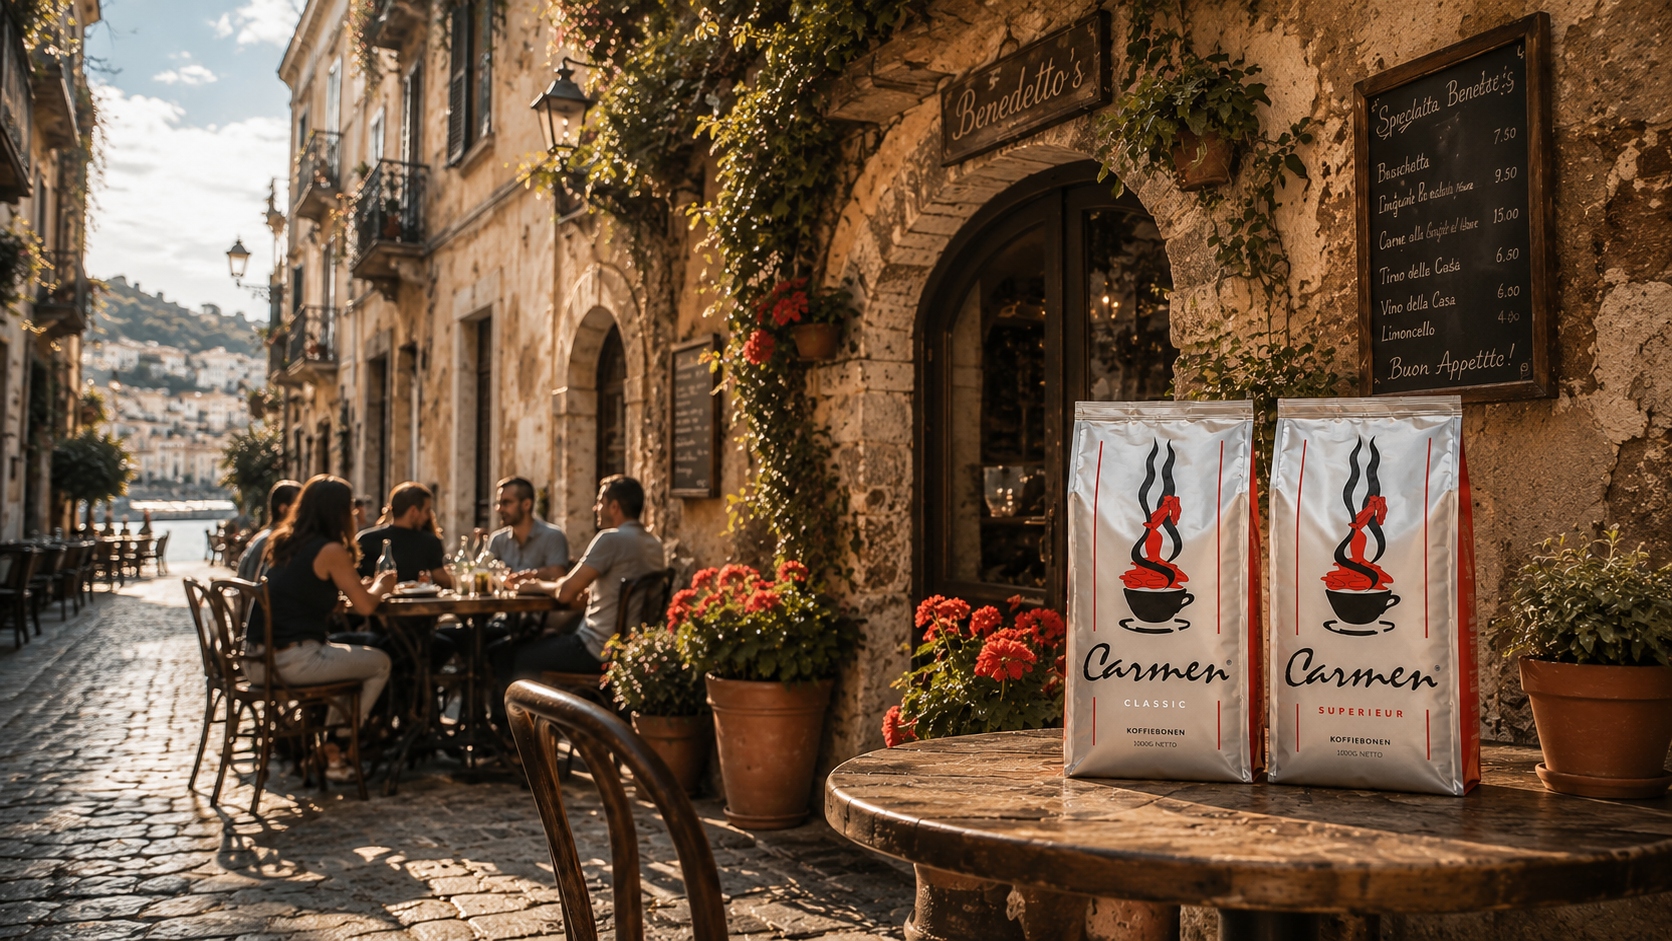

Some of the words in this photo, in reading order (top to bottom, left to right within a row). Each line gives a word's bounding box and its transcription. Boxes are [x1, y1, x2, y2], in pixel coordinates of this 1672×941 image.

[952, 47, 1086, 141] Benedetto's
[1493, 127, 1517, 145] 7.50
[1494, 166, 1518, 184] 9.50
[1493, 207, 1519, 224] 15.00
[1496, 247, 1520, 263] 6.50
[1380, 299, 1403, 316] Vino
[1432, 290, 1456, 309] Casa
[1381, 320, 1435, 343] Limoncello
[1389, 356, 1430, 381] Buon
[1123, 699, 1187, 709] CLASSIC
[1318, 706, 1404, 719] SUPERIEUR
[1126, 727, 1186, 736] KOFFIEBONEN
[1155, 740, 1178, 748] NETTO
[1329, 735, 1391, 746] KOFFIEBONEN
[1336, 749, 1358, 758] 1000G
[1359, 750, 1384, 759] NETTO
